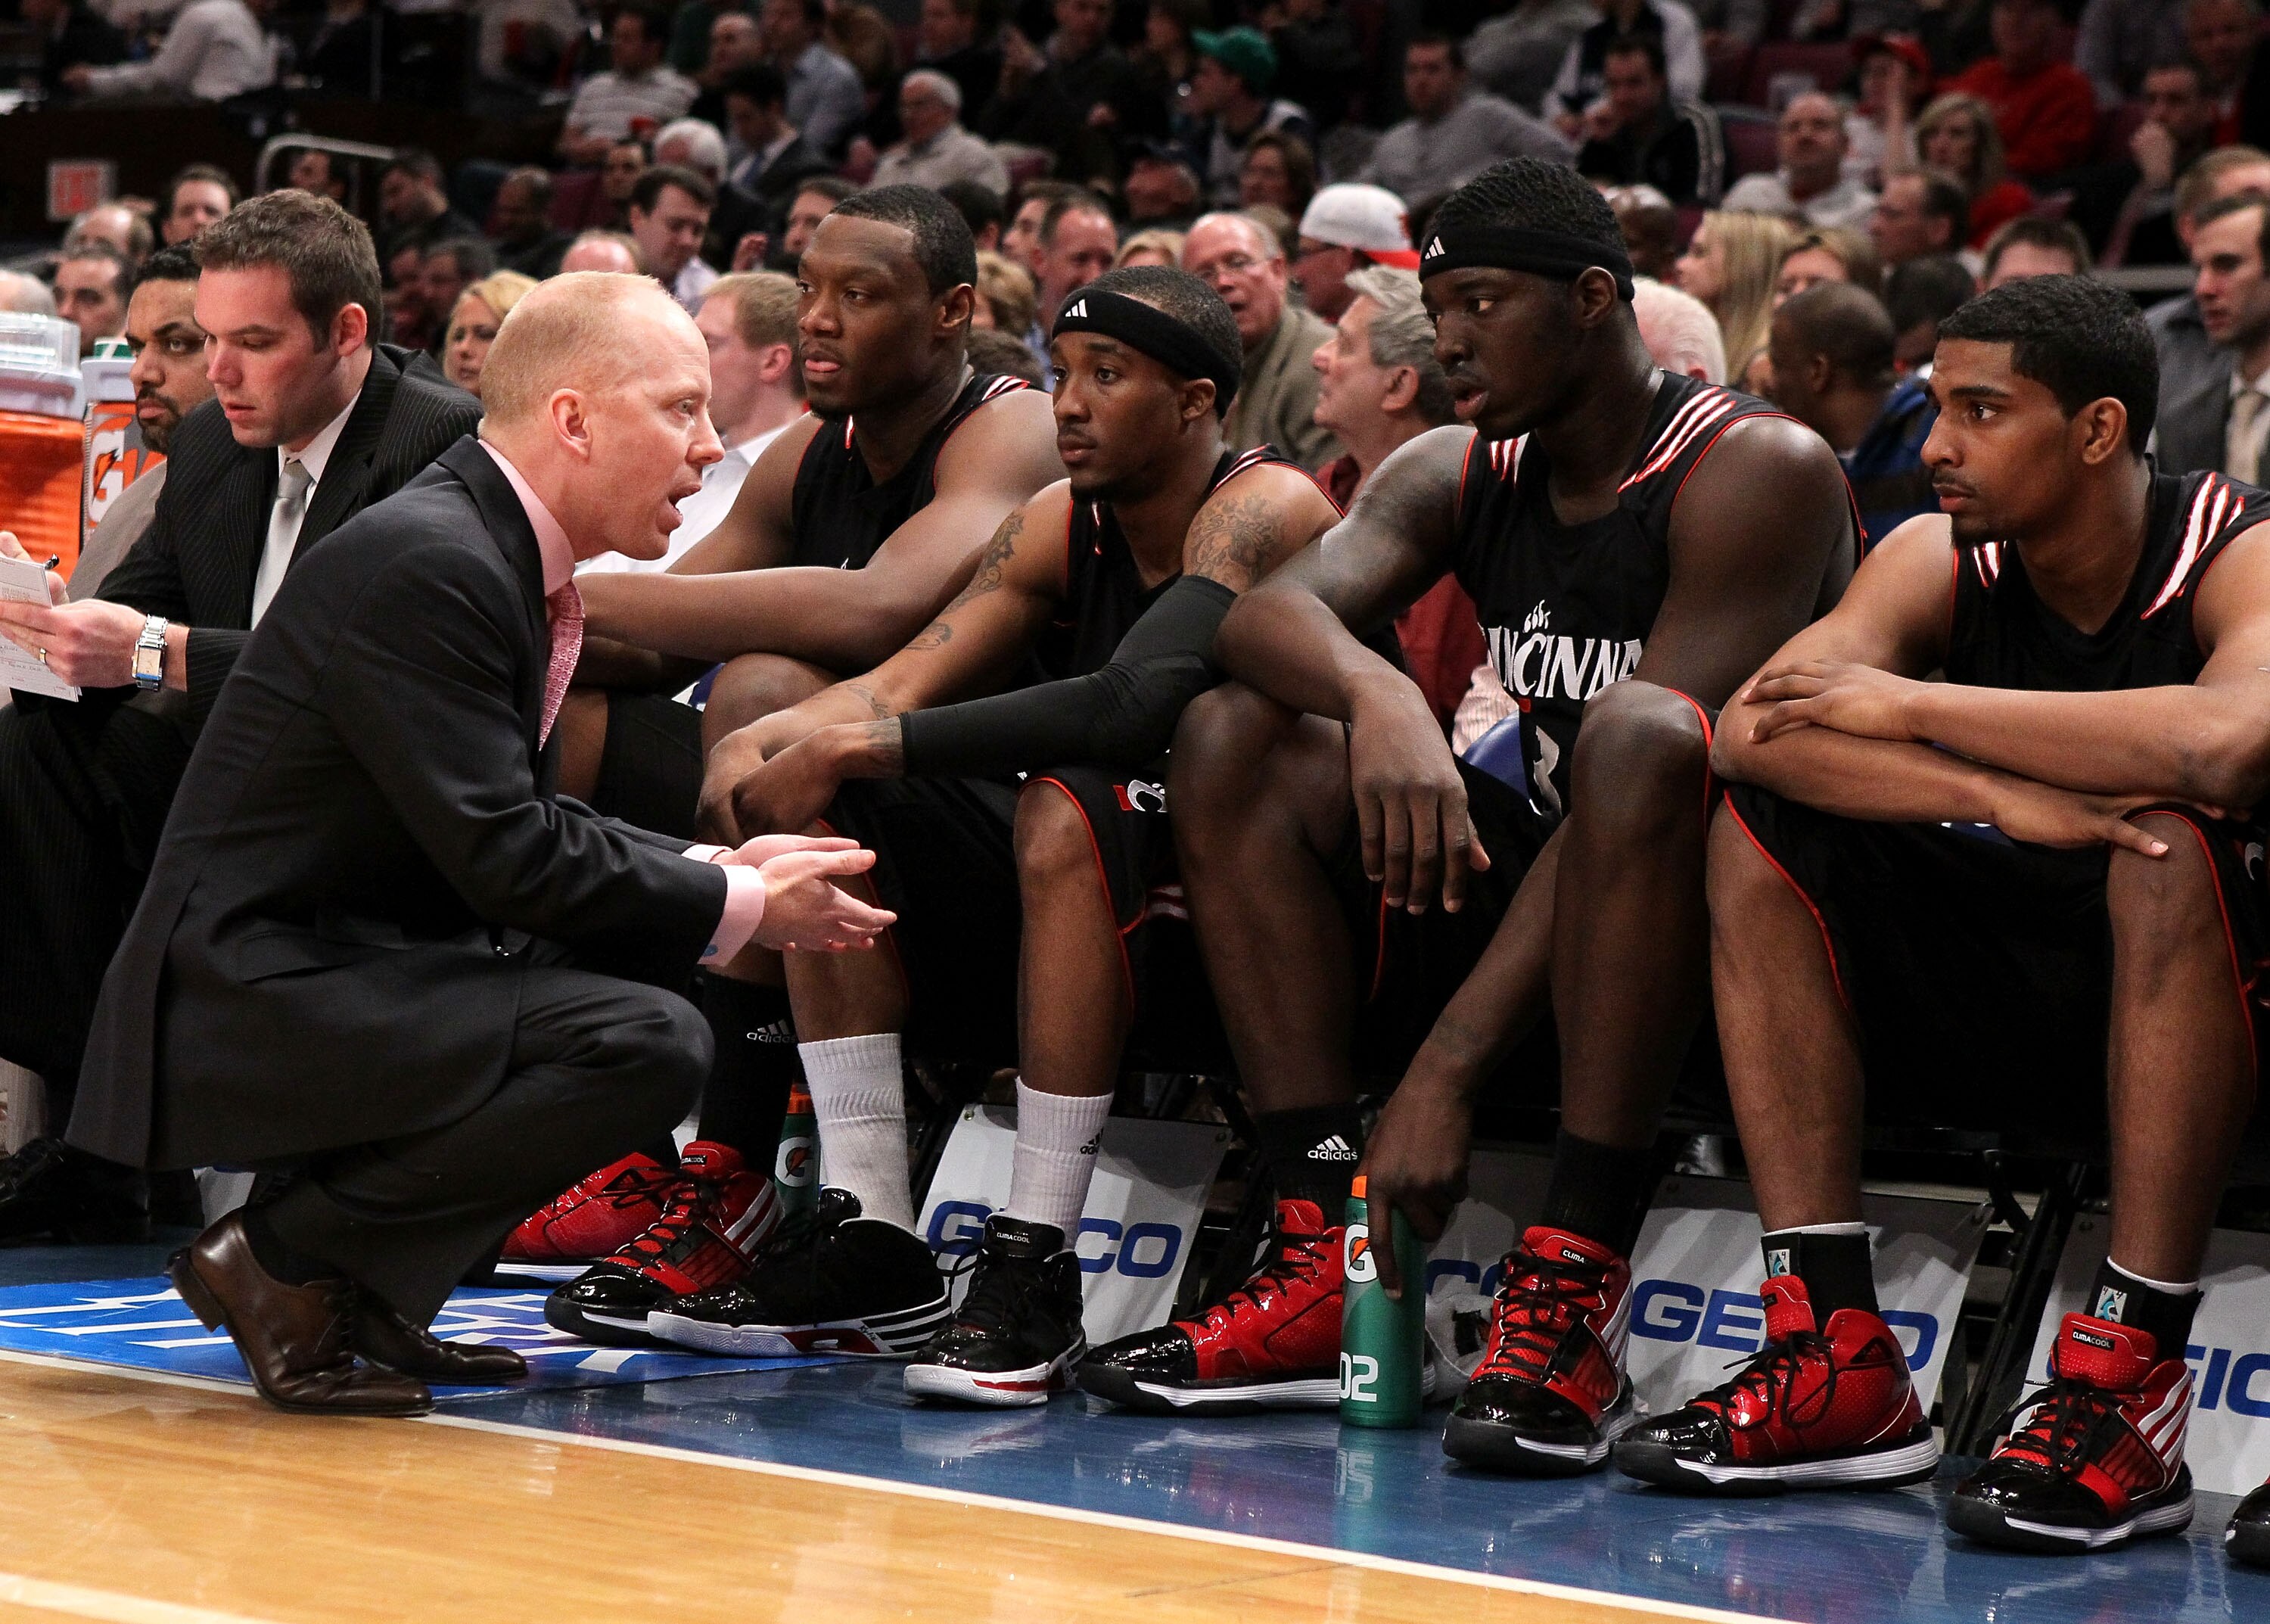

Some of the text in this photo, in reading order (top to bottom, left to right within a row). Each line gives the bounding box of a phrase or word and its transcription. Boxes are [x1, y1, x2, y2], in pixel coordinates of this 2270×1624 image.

[1307, 1149, 1358, 1161] adidas
[926, 1199, 1183, 1279] GCO
[1343, 1223, 1379, 1283] G
[1630, 1279, 1939, 1372] GEO
[2073, 1331, 2111, 1348] CLIMACOOL
